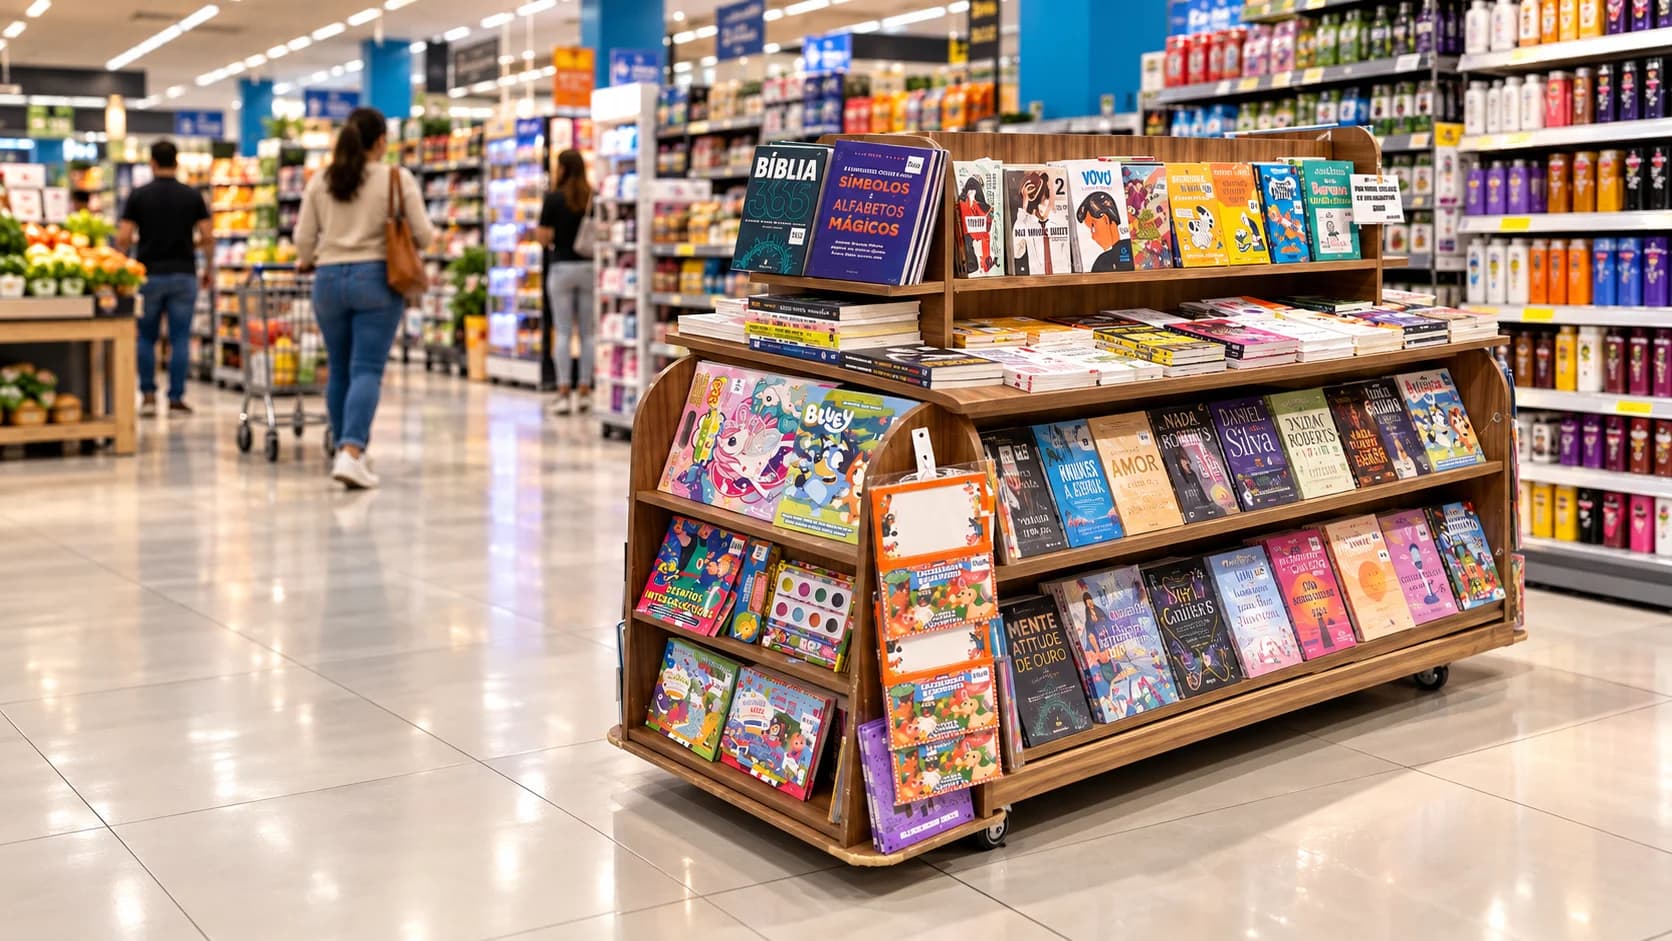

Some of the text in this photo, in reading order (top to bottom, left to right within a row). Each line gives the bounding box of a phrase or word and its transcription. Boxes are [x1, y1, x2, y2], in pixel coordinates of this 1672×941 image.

[754, 151, 817, 181] BÍBLIA
[838, 174, 910, 195] SÍMBOLOS
[1055, 178, 1065, 195] 2
[832, 199, 905, 218] ALFABETOS
[1225, 426, 1277, 458] Silva
[1111, 454, 1159, 478] AMOR
[1006, 612, 1057, 640] MENTE
[1012, 631, 1062, 657] ATITUDE
[1015, 648, 1067, 673] DE OURO
